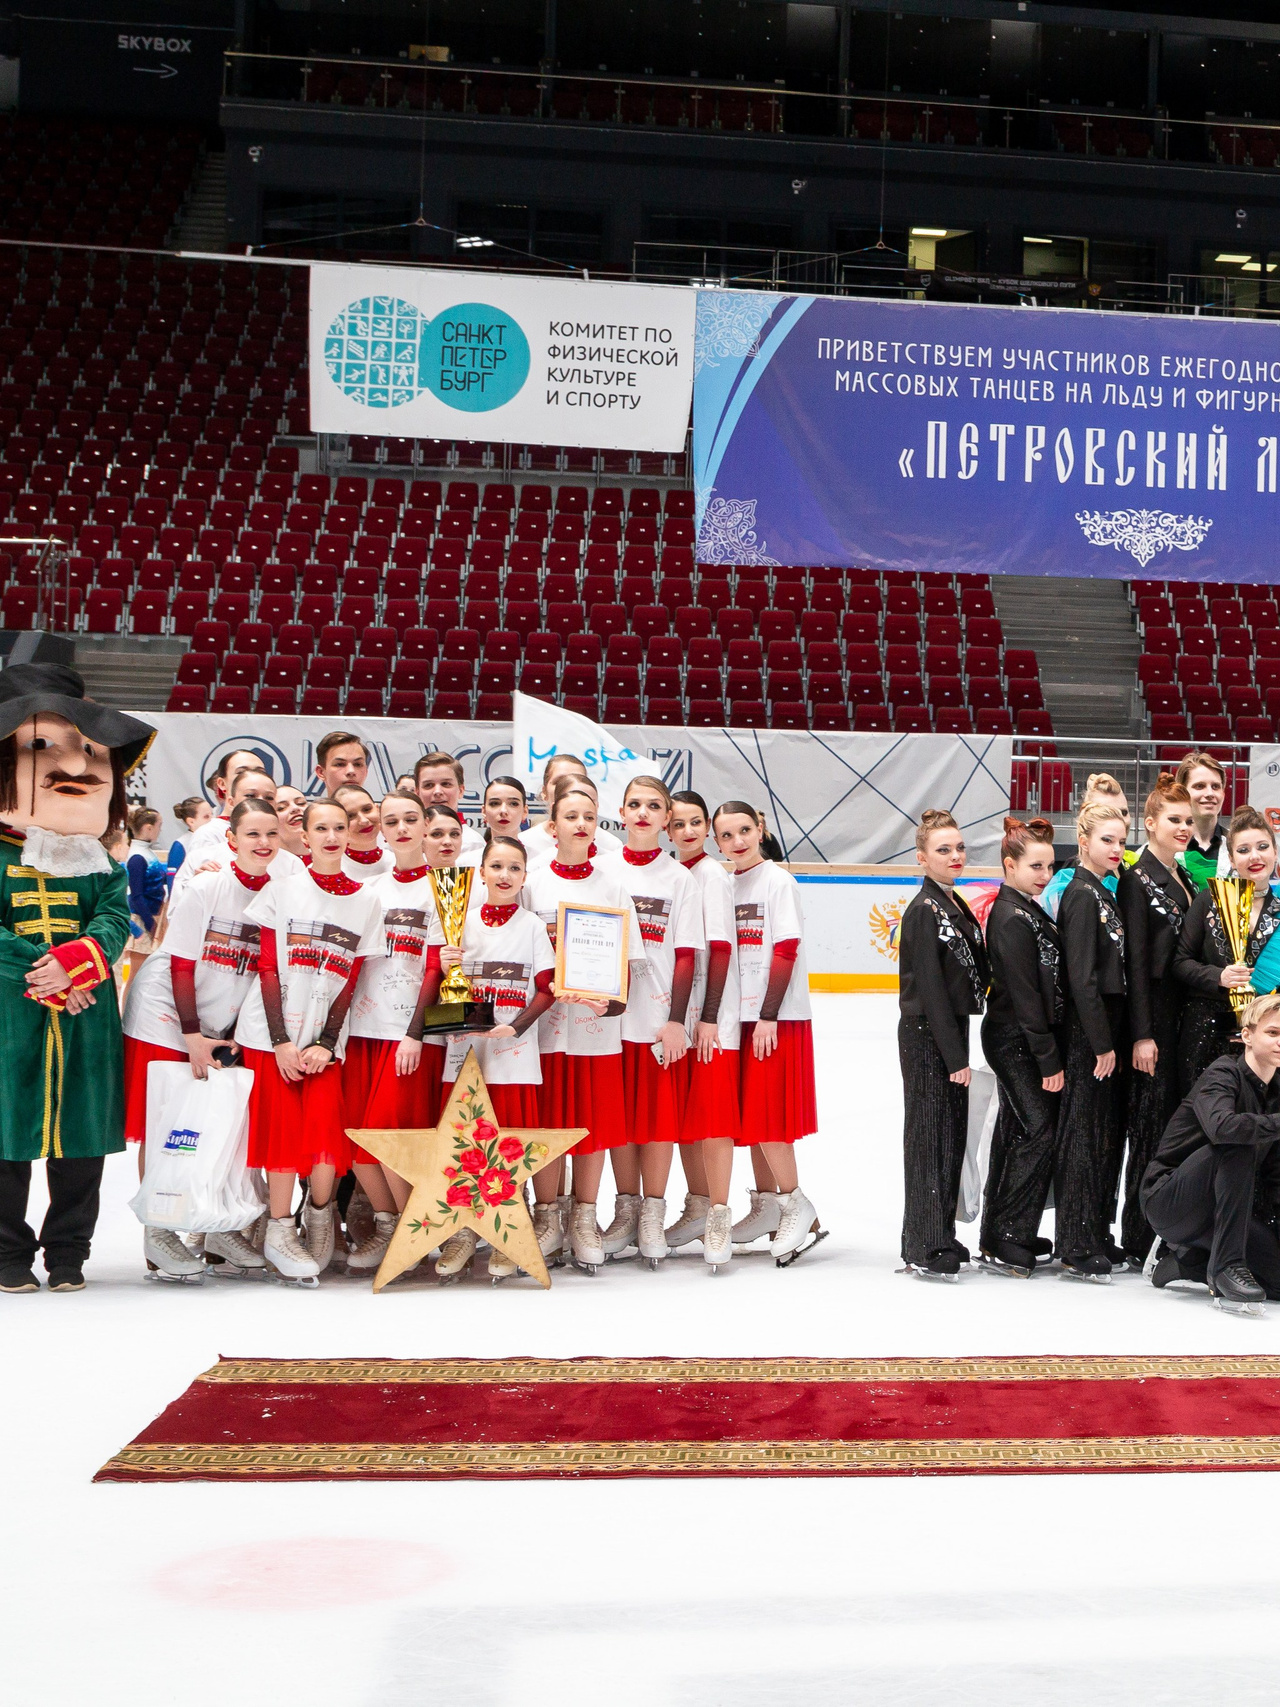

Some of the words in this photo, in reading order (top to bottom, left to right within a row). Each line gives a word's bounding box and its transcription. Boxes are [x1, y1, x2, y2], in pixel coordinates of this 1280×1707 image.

[118, 34, 192, 53] SKYBOX
[442, 321, 507, 345] САНКТ
[549, 321, 640, 342] КОМИТЕТ
[644, 326, 673, 343] ПО
[441, 345, 507, 370] ПЕТЕР
[547, 344, 679, 367] ФИЗИЧЕСКОЙ
[817, 337, 993, 368] ПРИВЕТСТВУЕМ
[1002, 348, 1150, 376] УЧАСТНИКОВ
[440, 369, 494, 393] БУРГ
[547, 367, 637, 387] КУЛЬТУРЕ
[547, 390, 559, 405] И
[565, 391, 641, 410] СПОРТУ
[834, 370, 959, 397] МАССОВЫХ
[970, 377, 1055, 403] ТАНЦЕВ
[1065, 382, 1093, 404] НА
[1102, 383, 1163, 409] ЛЬДУ
[1172, 387, 1186, 408] И
[898, 420, 1228, 491] «ПЕТРОВСКИЙ
